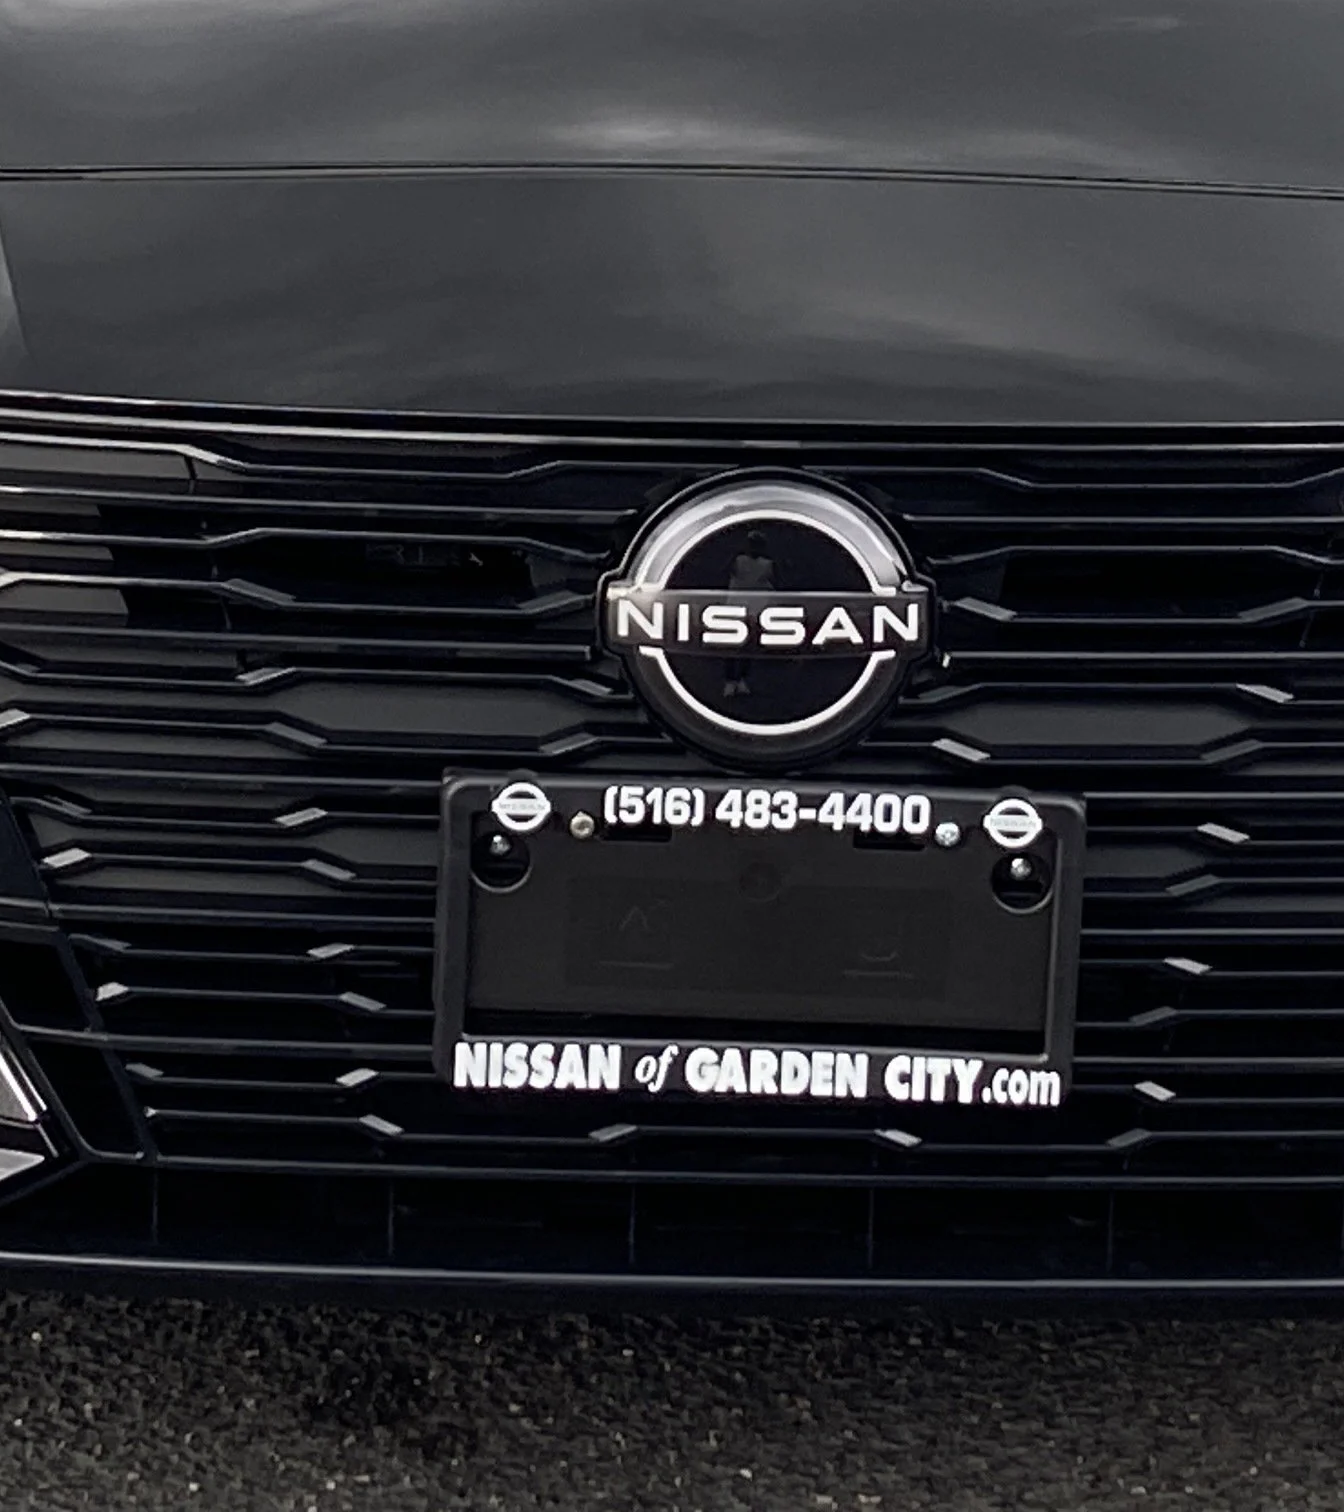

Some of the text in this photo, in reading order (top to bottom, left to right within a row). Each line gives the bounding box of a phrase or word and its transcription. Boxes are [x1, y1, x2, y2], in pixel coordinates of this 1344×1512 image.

[616, 599, 919, 646] NISSAN
[604, 785, 932, 835] (516) 483-4400
[453, 1042, 1061, 1106] NISSAN of GARDEN CITY.com
